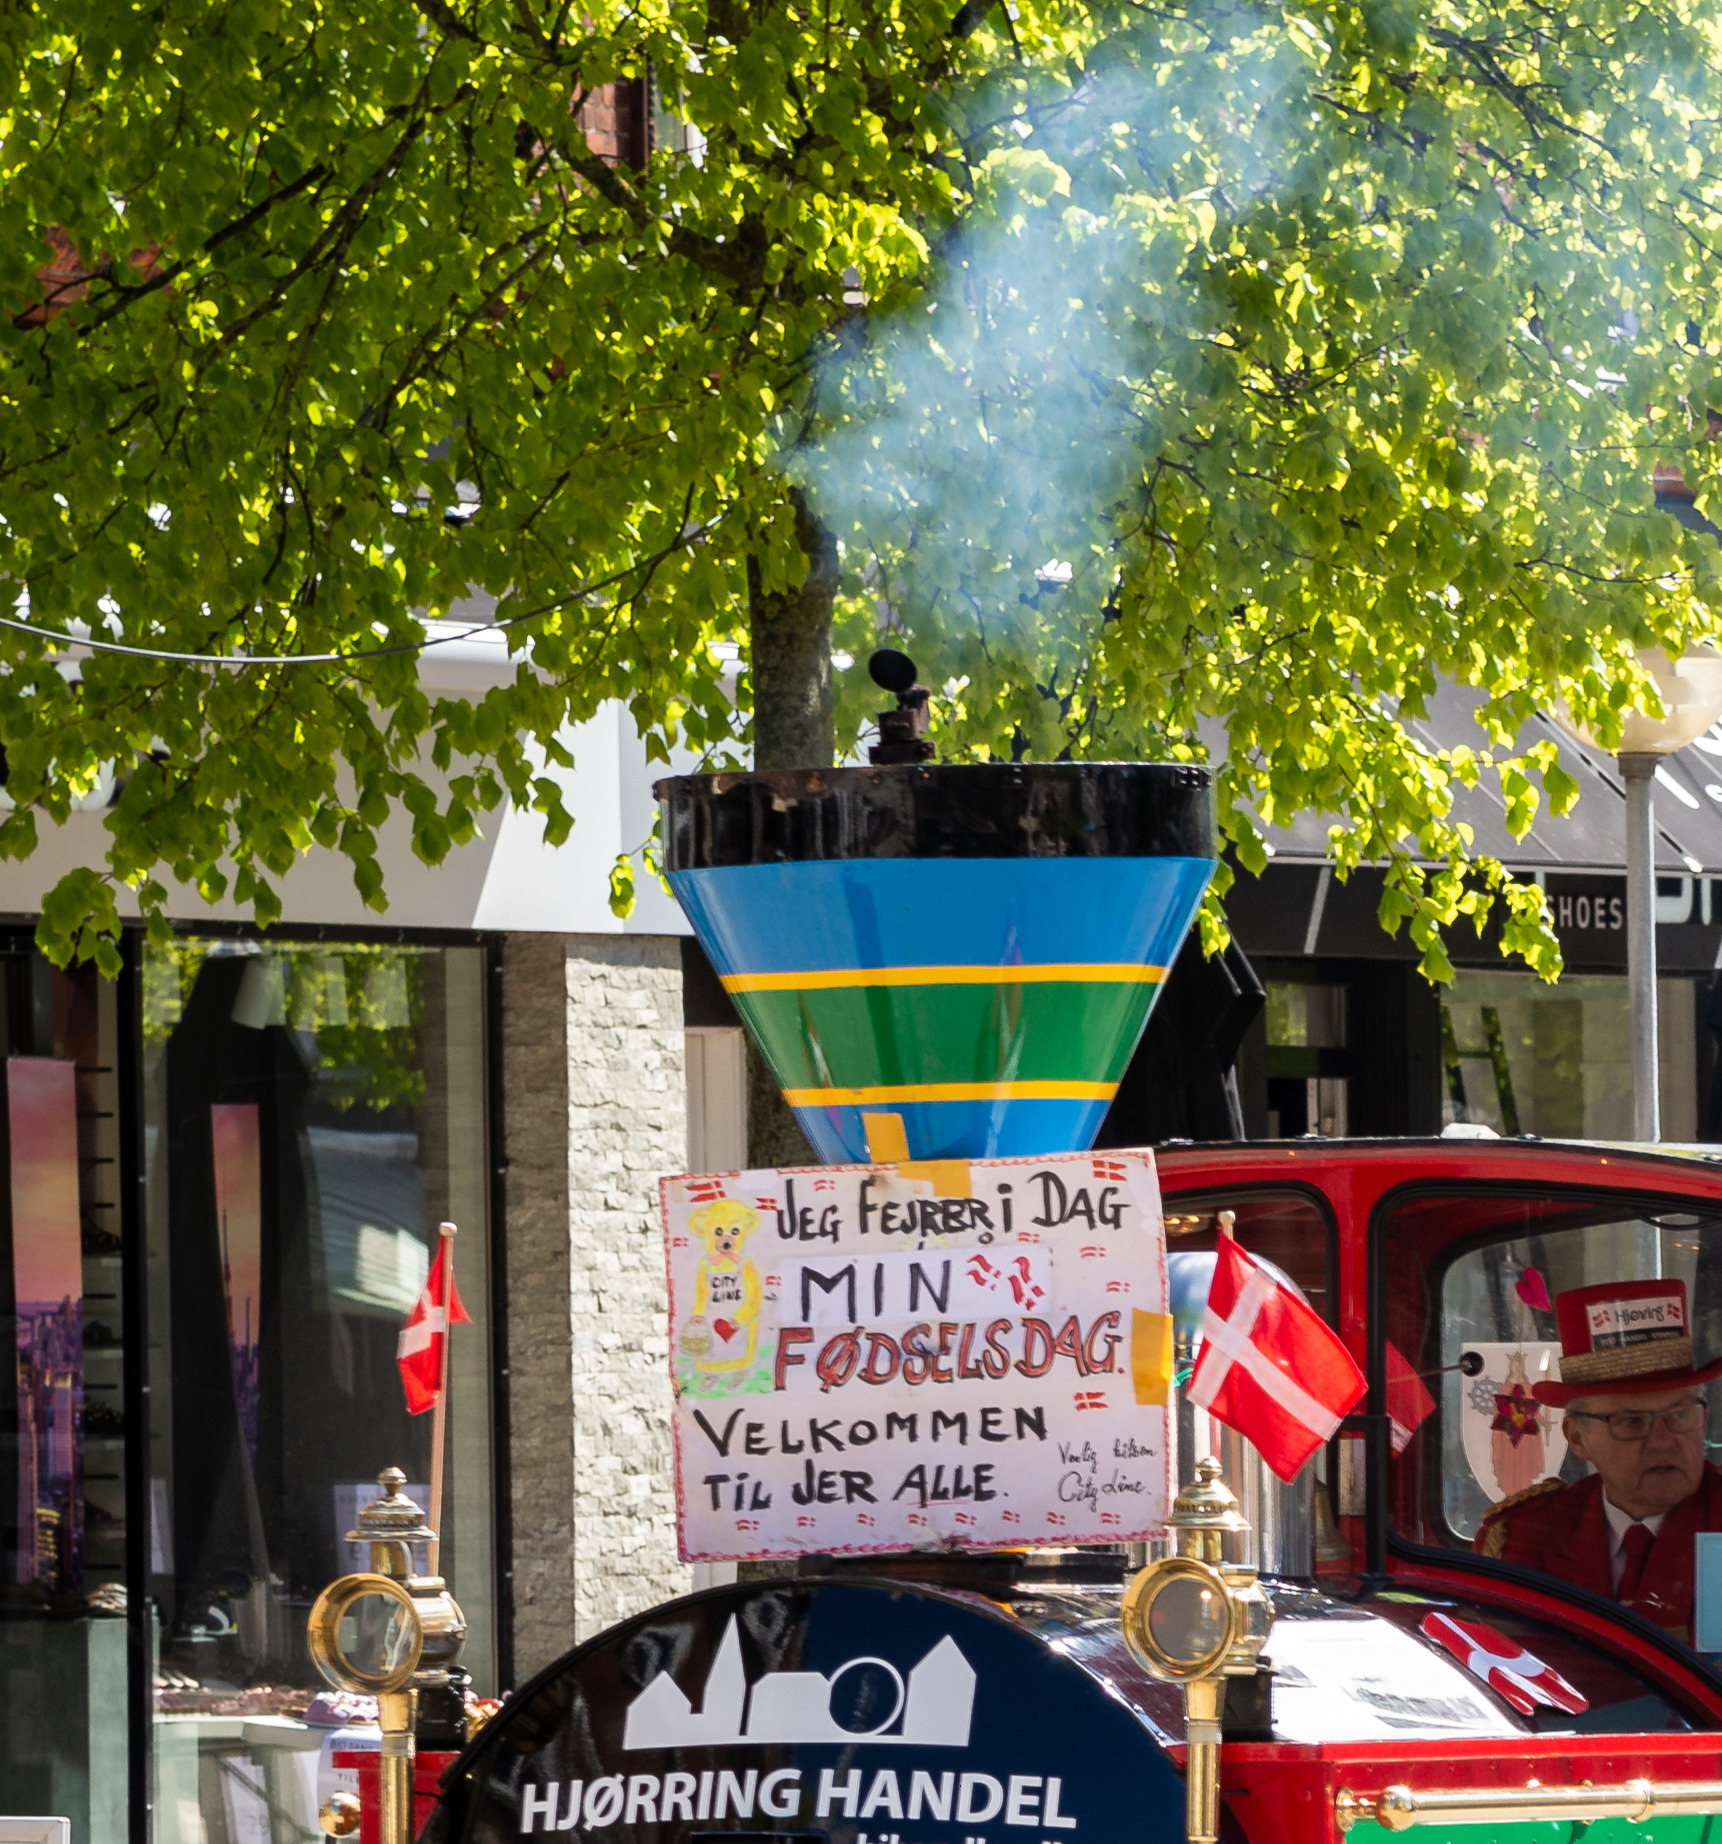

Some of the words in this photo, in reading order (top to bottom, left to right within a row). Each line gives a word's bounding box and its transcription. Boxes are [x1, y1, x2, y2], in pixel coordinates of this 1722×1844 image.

[1031, 1171, 1130, 1231] DAG
[711, 1276, 738, 1290] CITY
[801, 1259, 952, 1323] MIN
[693, 1405, 1048, 1456] VELKOMMEN
[792, 1458, 873, 1506] JER
[1058, 1471, 1098, 1511] City
[521, 1768, 800, 1834] HJØRRING
[816, 1768, 1077, 1830] HANDEL
